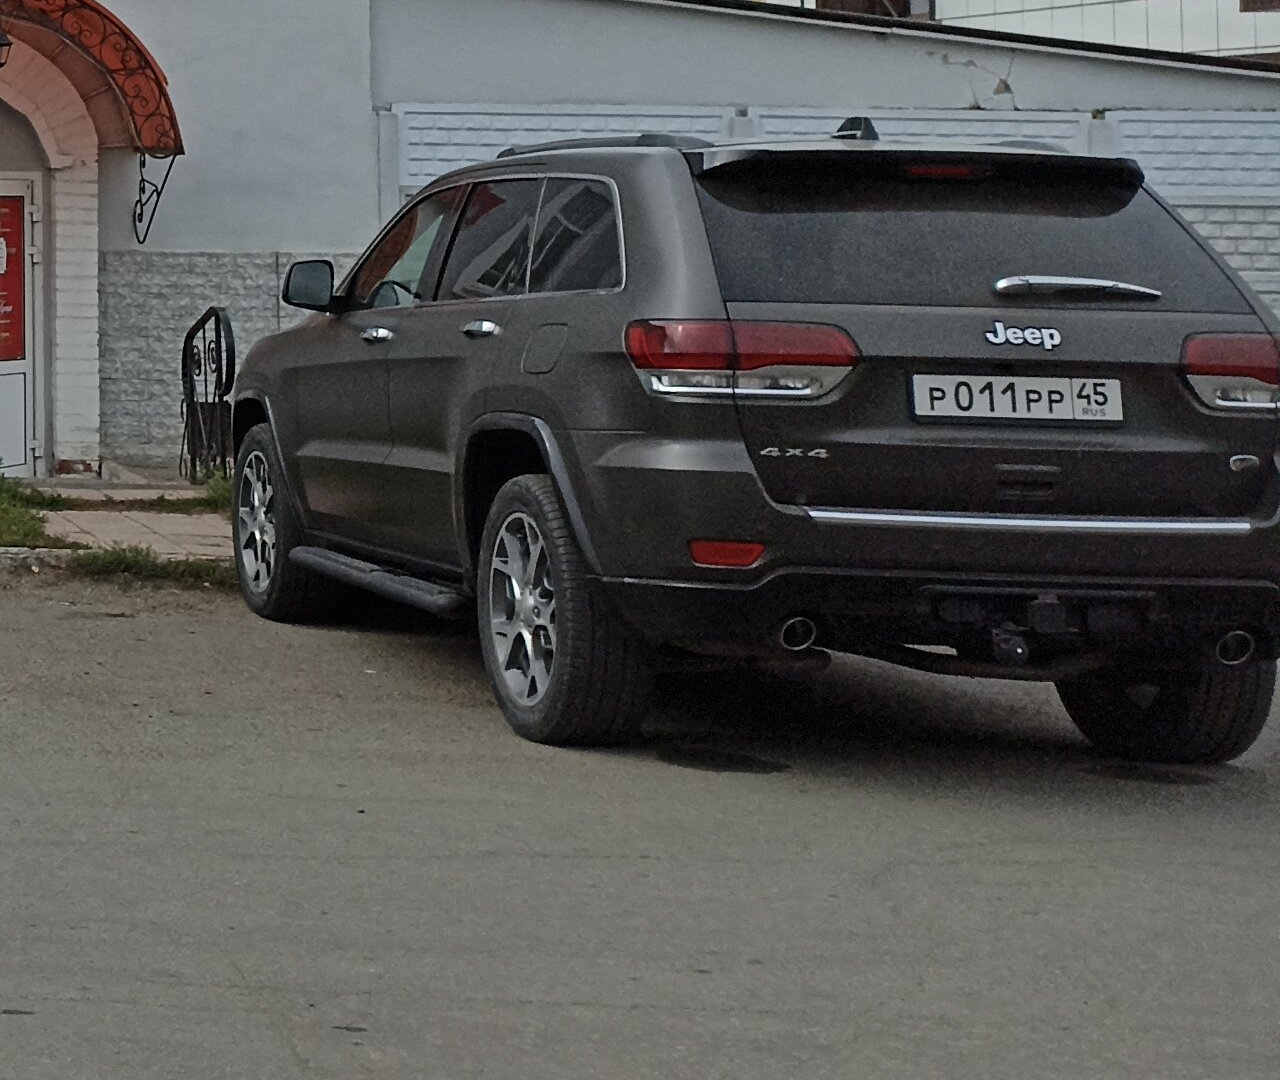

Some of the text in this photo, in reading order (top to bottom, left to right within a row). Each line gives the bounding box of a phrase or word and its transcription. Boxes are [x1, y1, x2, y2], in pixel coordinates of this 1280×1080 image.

[985, 320, 1062, 350] Jeep
[1076, 382, 1109, 407] 45
[1082, 407, 1107, 417] RUS
